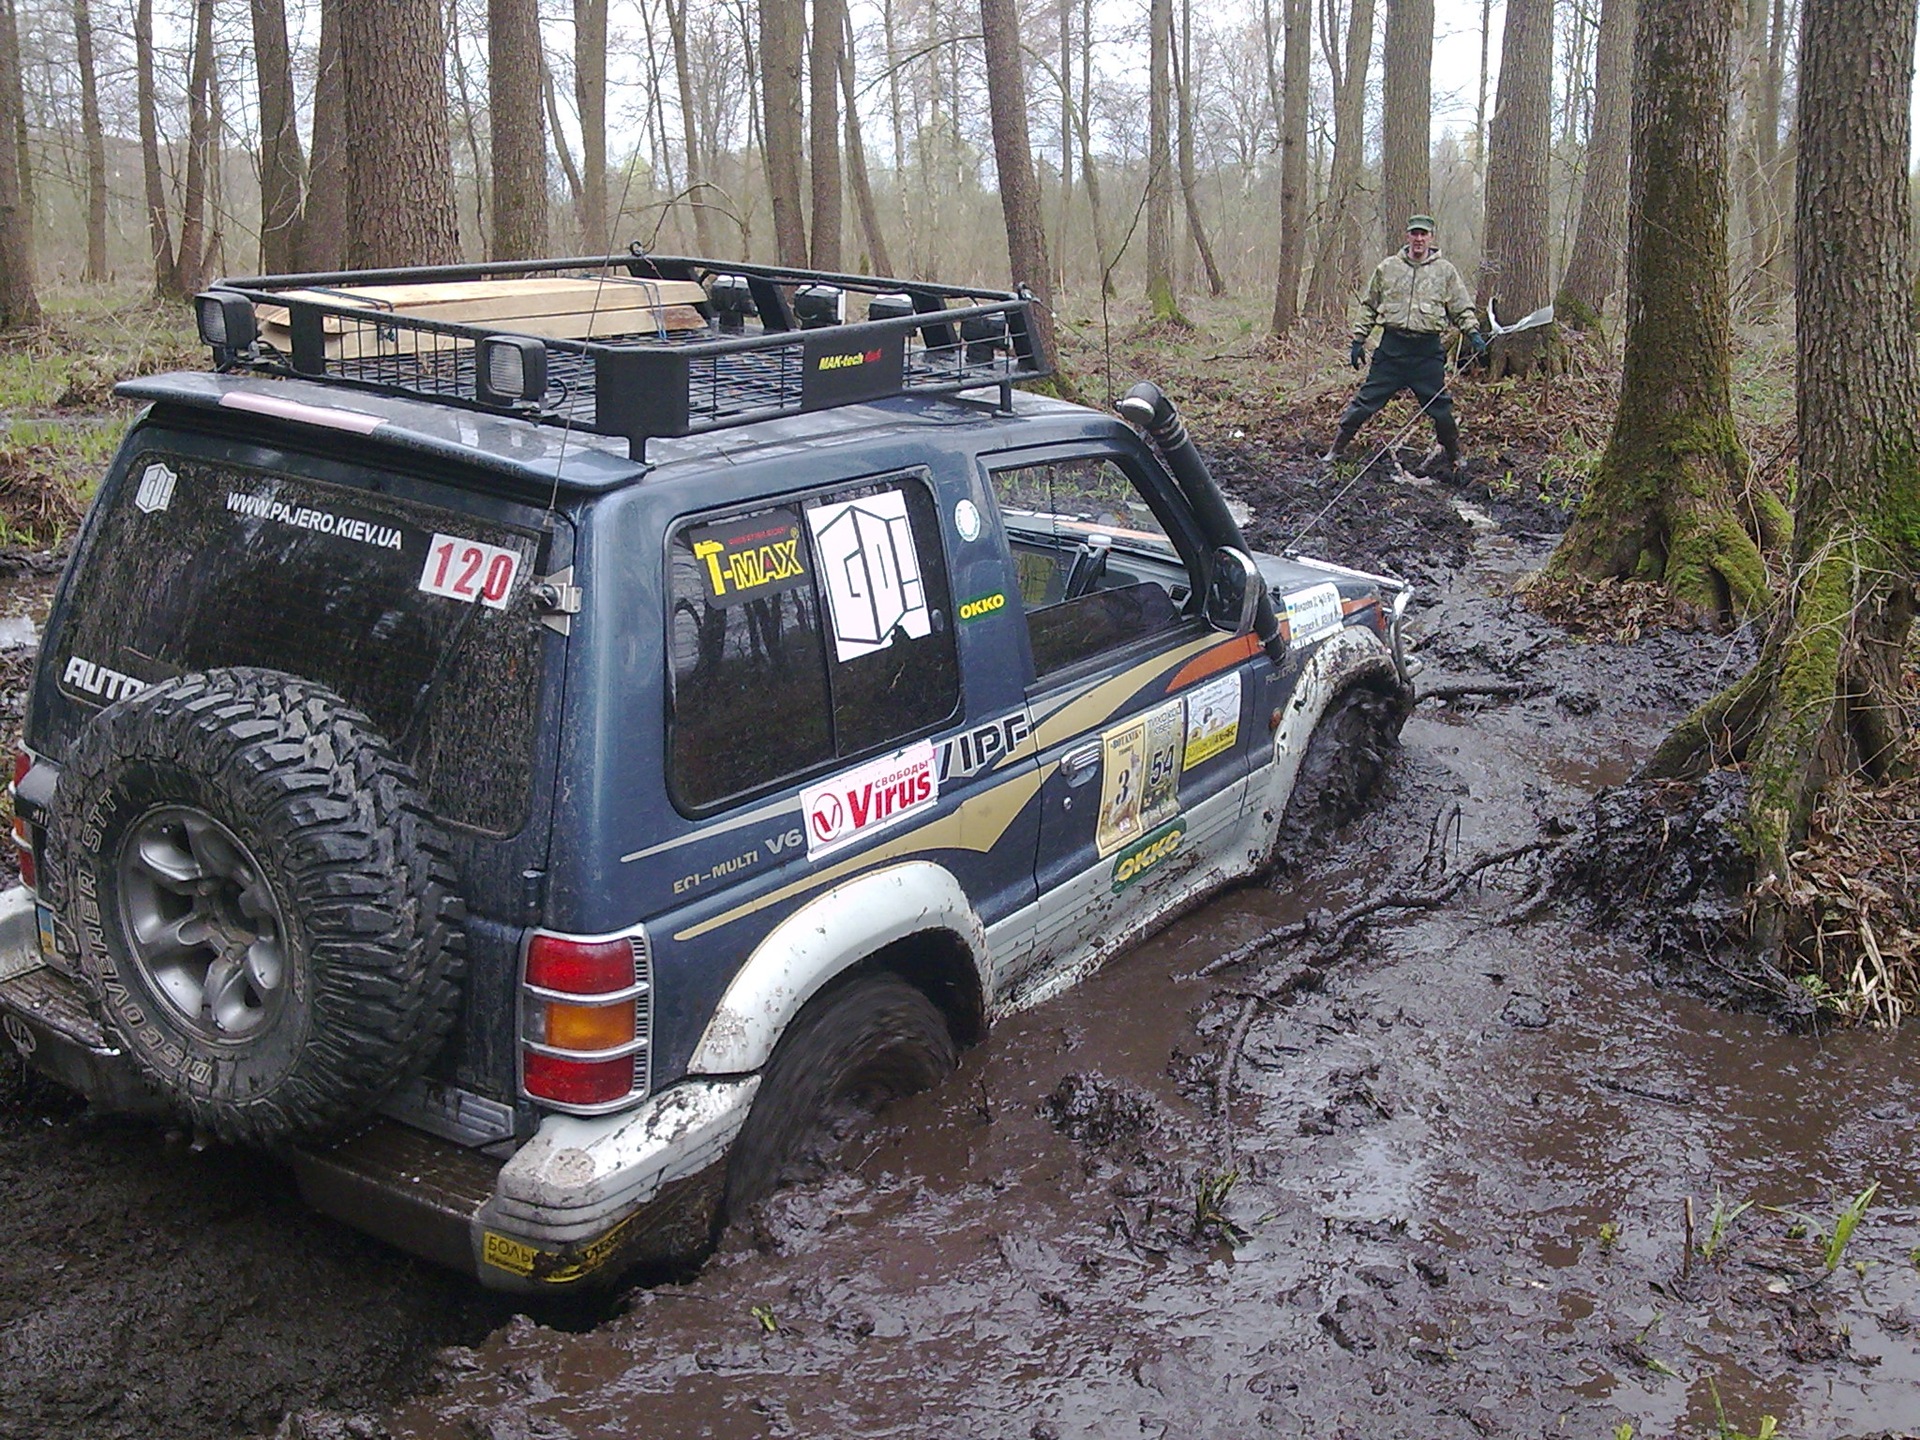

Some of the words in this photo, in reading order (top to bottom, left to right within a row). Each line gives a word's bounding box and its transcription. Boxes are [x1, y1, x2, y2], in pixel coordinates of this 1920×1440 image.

[818, 352, 864, 370] MAK-tech
[226, 492, 403, 550] WWW.PAJERO.KIEV.UA
[433, 543, 513, 601] 120
[693, 540, 804, 596] T-MAX
[875, 760, 929, 788] СВОБОДЫ
[1116, 769, 1130, 805] 3
[1151, 744, 1175, 785] 54
[82, 789, 117, 853] STT
[847, 771, 932, 829] Virus
[765, 828, 803, 854] V6
[78, 869, 212, 1085] DISCOVERER
